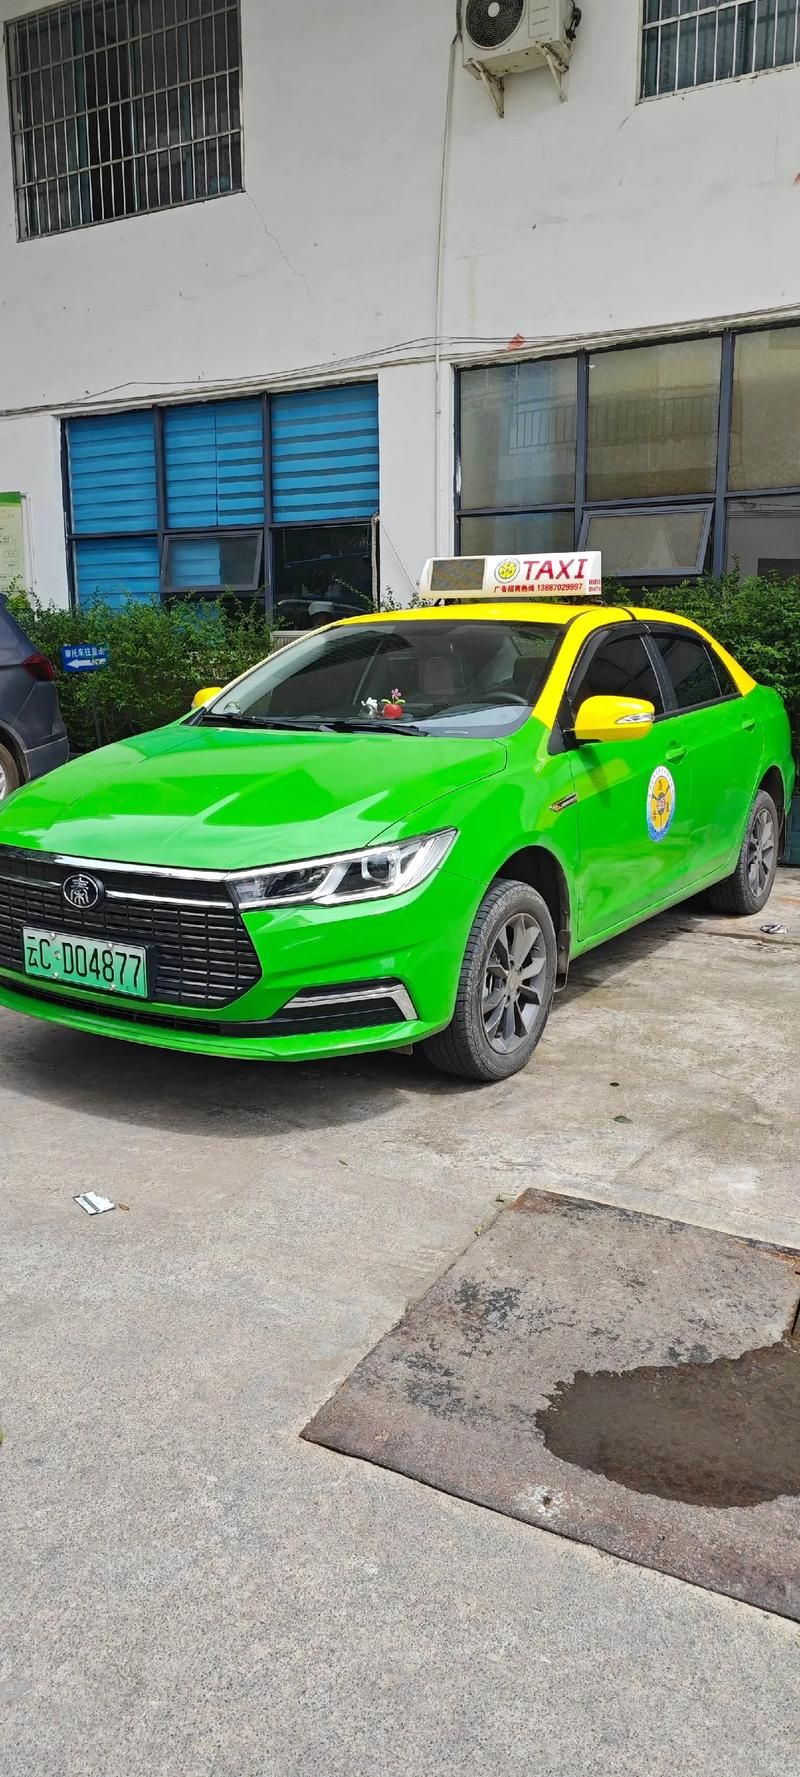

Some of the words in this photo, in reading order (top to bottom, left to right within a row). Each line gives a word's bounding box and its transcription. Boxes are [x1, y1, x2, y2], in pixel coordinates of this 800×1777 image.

[523, 558, 588, 581] TAXI
[493, 584, 535, 593] 广告招商热线
